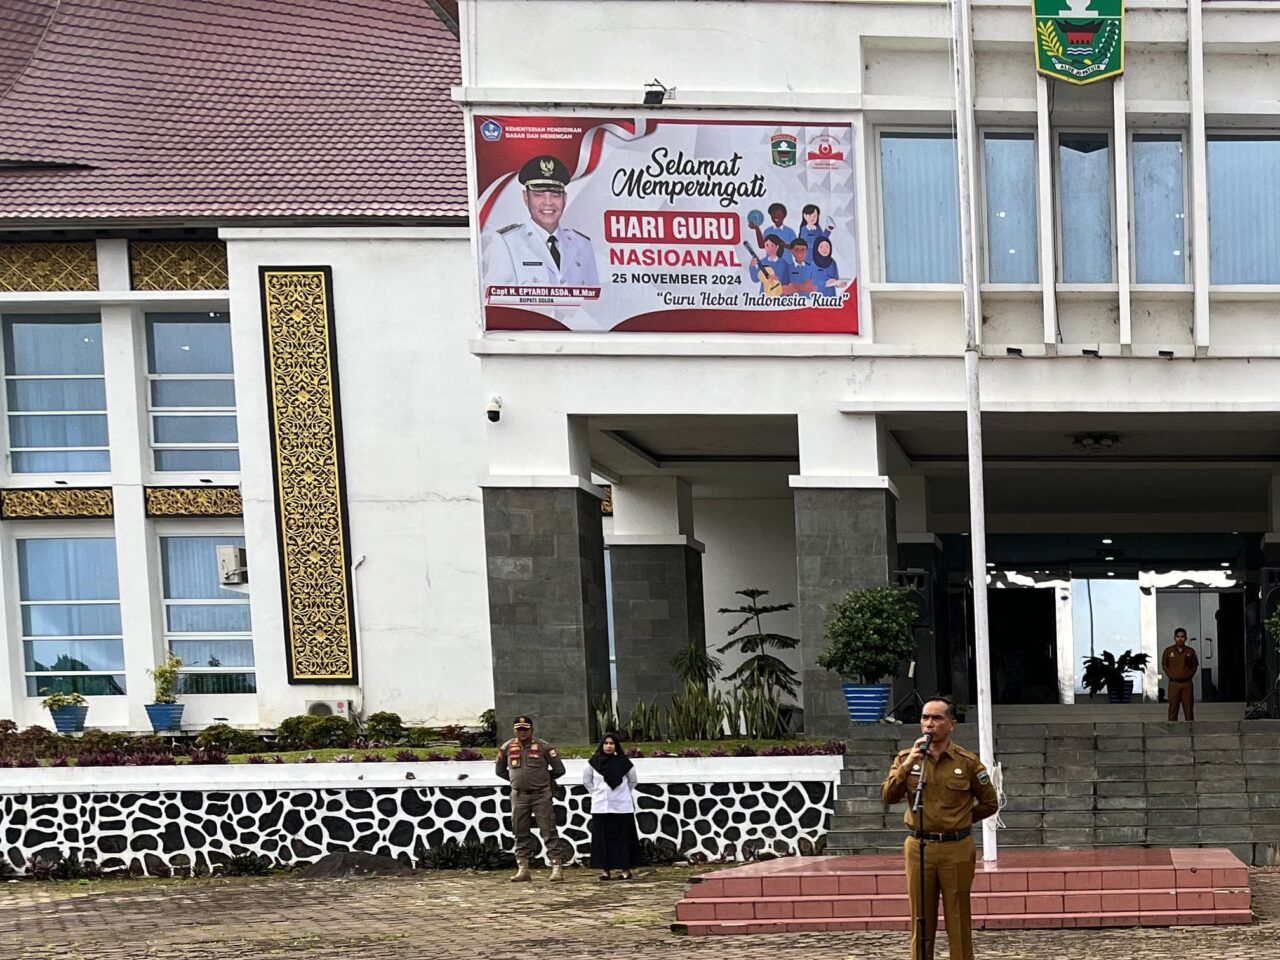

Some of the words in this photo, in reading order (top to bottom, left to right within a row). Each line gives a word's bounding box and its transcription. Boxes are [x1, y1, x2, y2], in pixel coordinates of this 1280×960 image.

[646, 147, 743, 176] Selamat
[611, 167, 766, 207] Memperingati
[610, 216, 665, 239] HARI
[672, 216, 735, 240] GURU
[609, 248, 742, 268] NASIOANAL
[612, 274, 628, 284] 25
[631, 274, 708, 285] NOVEMBER
[711, 274, 742, 286] 2024
[490, 287, 508, 296] Capt
[518, 288, 548, 296] EPYARDI
[550, 288, 572, 297] ASDA,
[573, 289, 596, 297] M.Mar
[700, 292, 738, 306] Hebat
[743, 292, 806, 308] Indonesia
